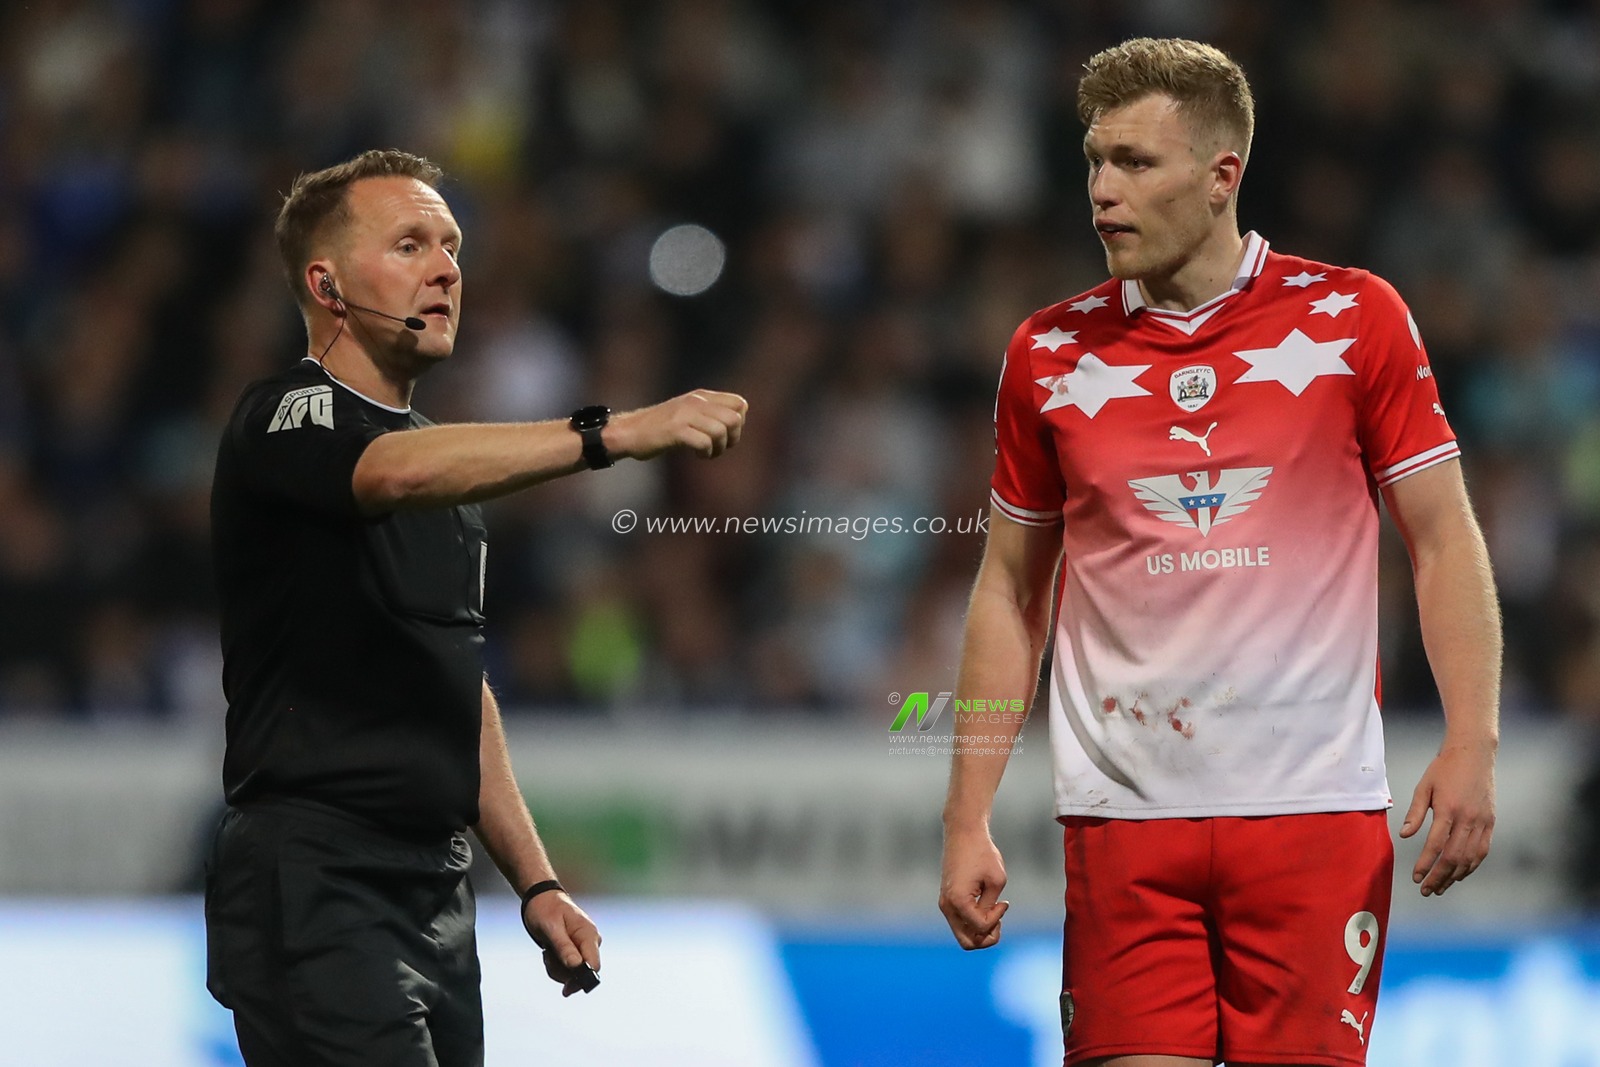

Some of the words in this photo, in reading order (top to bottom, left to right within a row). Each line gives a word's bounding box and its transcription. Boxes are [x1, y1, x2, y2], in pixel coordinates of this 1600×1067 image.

[284, 387, 323, 404] SPORTS
[1146, 553, 1175, 575] US
[1180, 546, 1270, 572] MOBILE
[1344, 910, 1379, 995] 9
